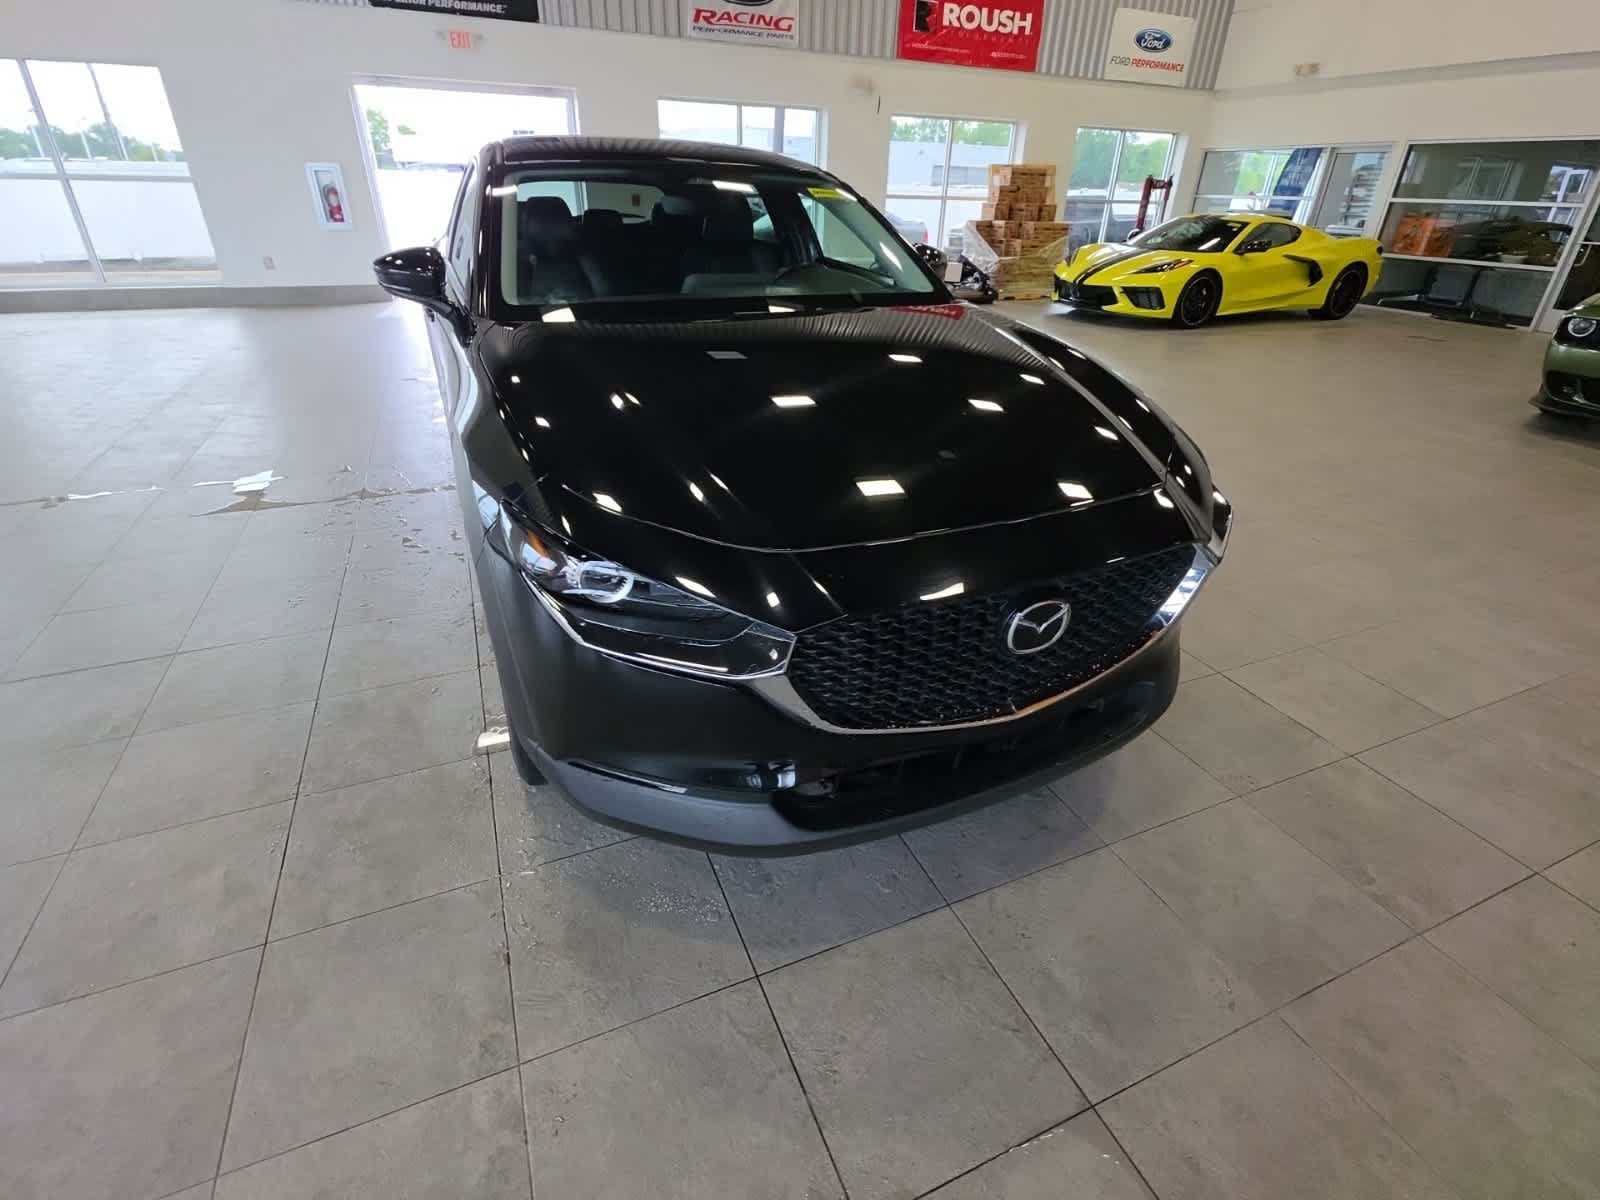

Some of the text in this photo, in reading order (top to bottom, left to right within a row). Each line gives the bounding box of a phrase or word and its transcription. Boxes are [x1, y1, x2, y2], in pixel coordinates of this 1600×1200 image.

[693, 8, 795, 32] RACING
[942, 3, 1033, 35] ROUSH
[450, 31, 472, 49] EXIT
[692, 25, 794, 40] PERFORMANCE PARTS
[1141, 31, 1166, 49] Ford
[1109, 56, 1185, 72] FORD PERFORMANCE
